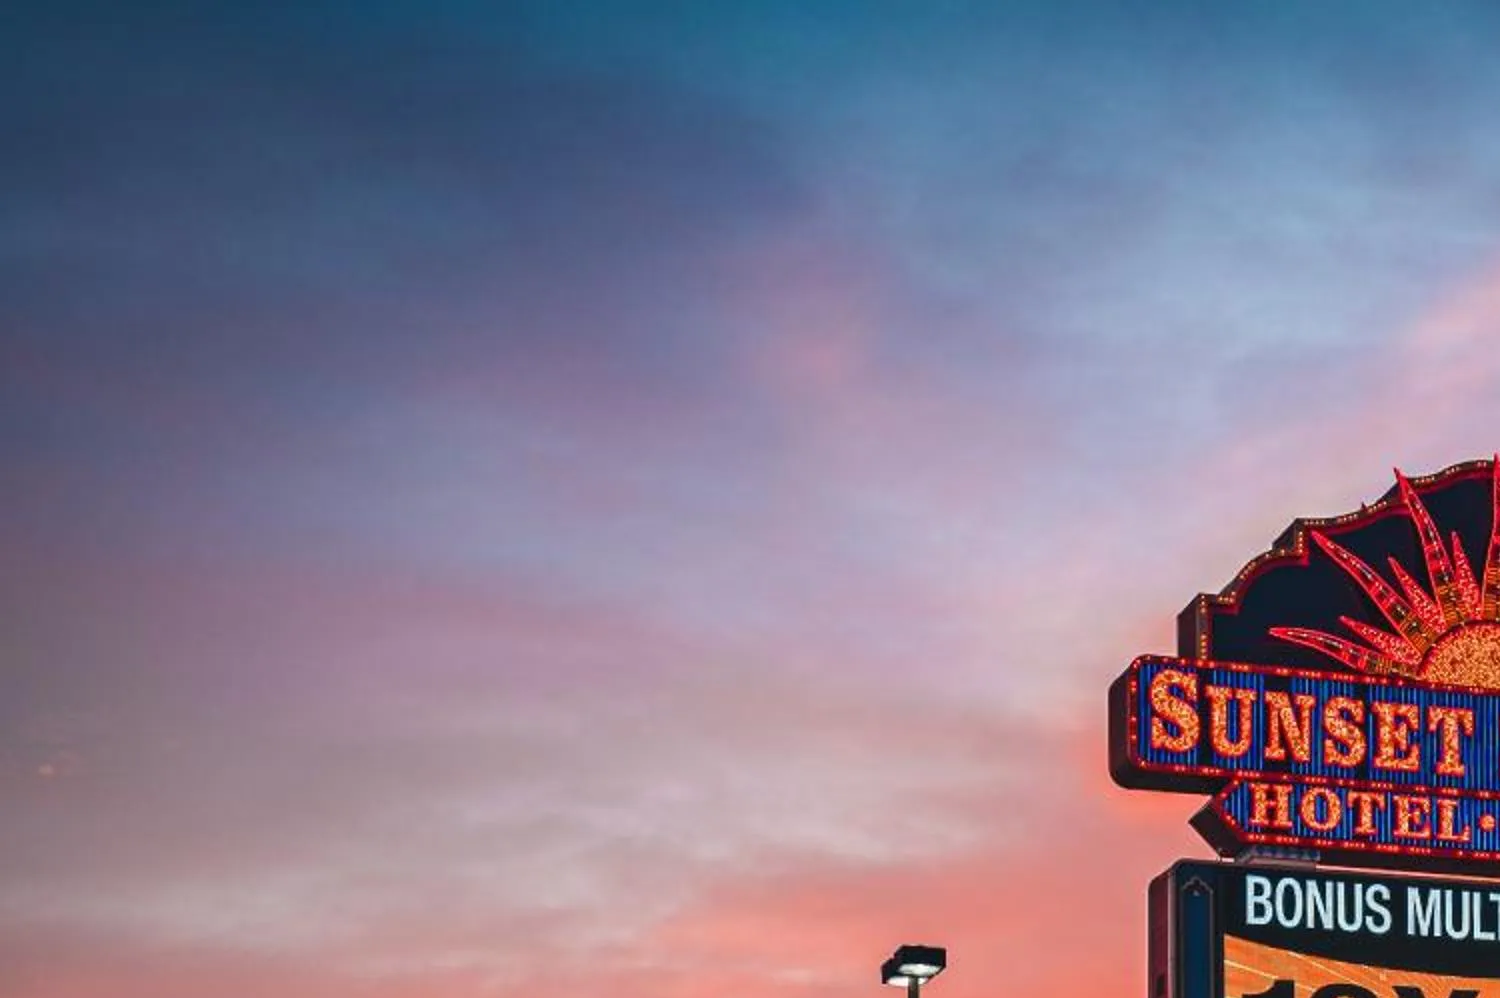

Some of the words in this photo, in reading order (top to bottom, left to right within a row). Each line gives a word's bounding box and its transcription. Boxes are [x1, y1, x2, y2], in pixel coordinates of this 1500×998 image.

[1149, 670, 1474, 775] SUNSET
[1248, 782, 1470, 843] HOTEL
[1246, 876, 1391, 933] BONUS
